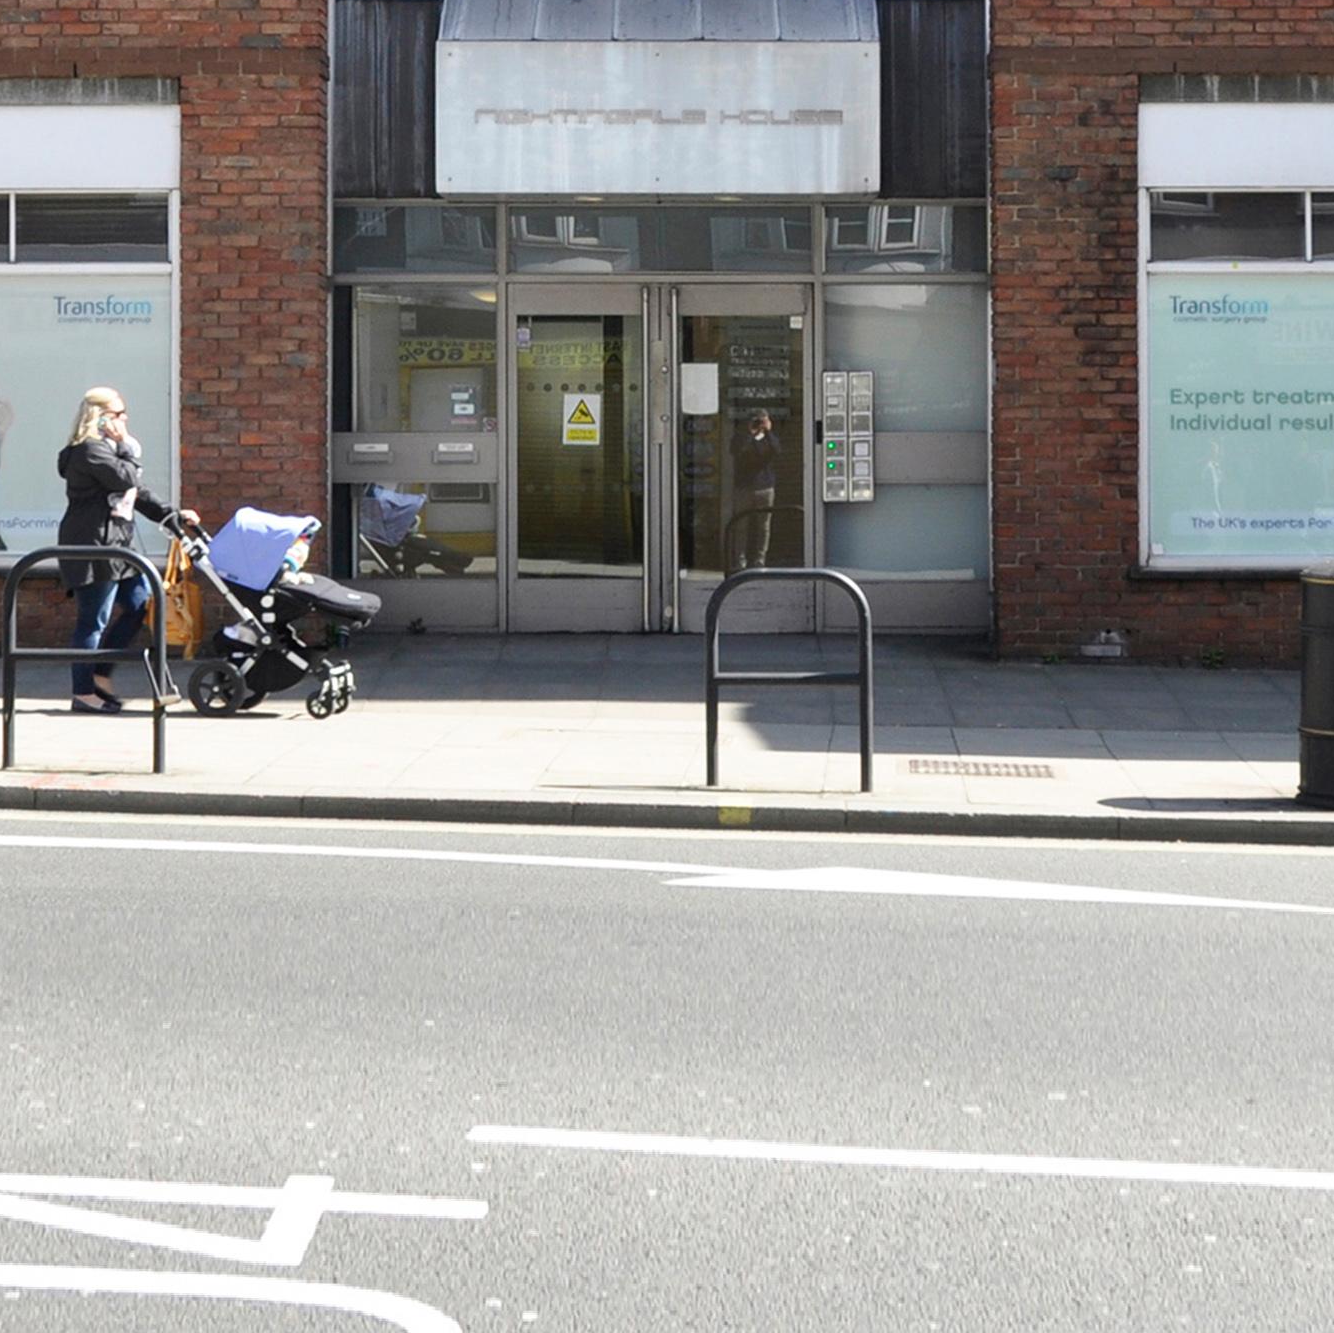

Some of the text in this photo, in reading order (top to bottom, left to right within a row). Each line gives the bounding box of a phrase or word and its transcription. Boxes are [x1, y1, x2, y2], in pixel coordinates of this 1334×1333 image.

[53, 294, 152, 315] Transform
[1169, 294, 1269, 314] Transform
[1170, 389, 1245, 409] Expert
[1170, 414, 1272, 431] Individual
[1191, 517, 1215, 529] The
[1218, 517, 1247, 529] UK's
[1250, 518, 1305, 532] experts
